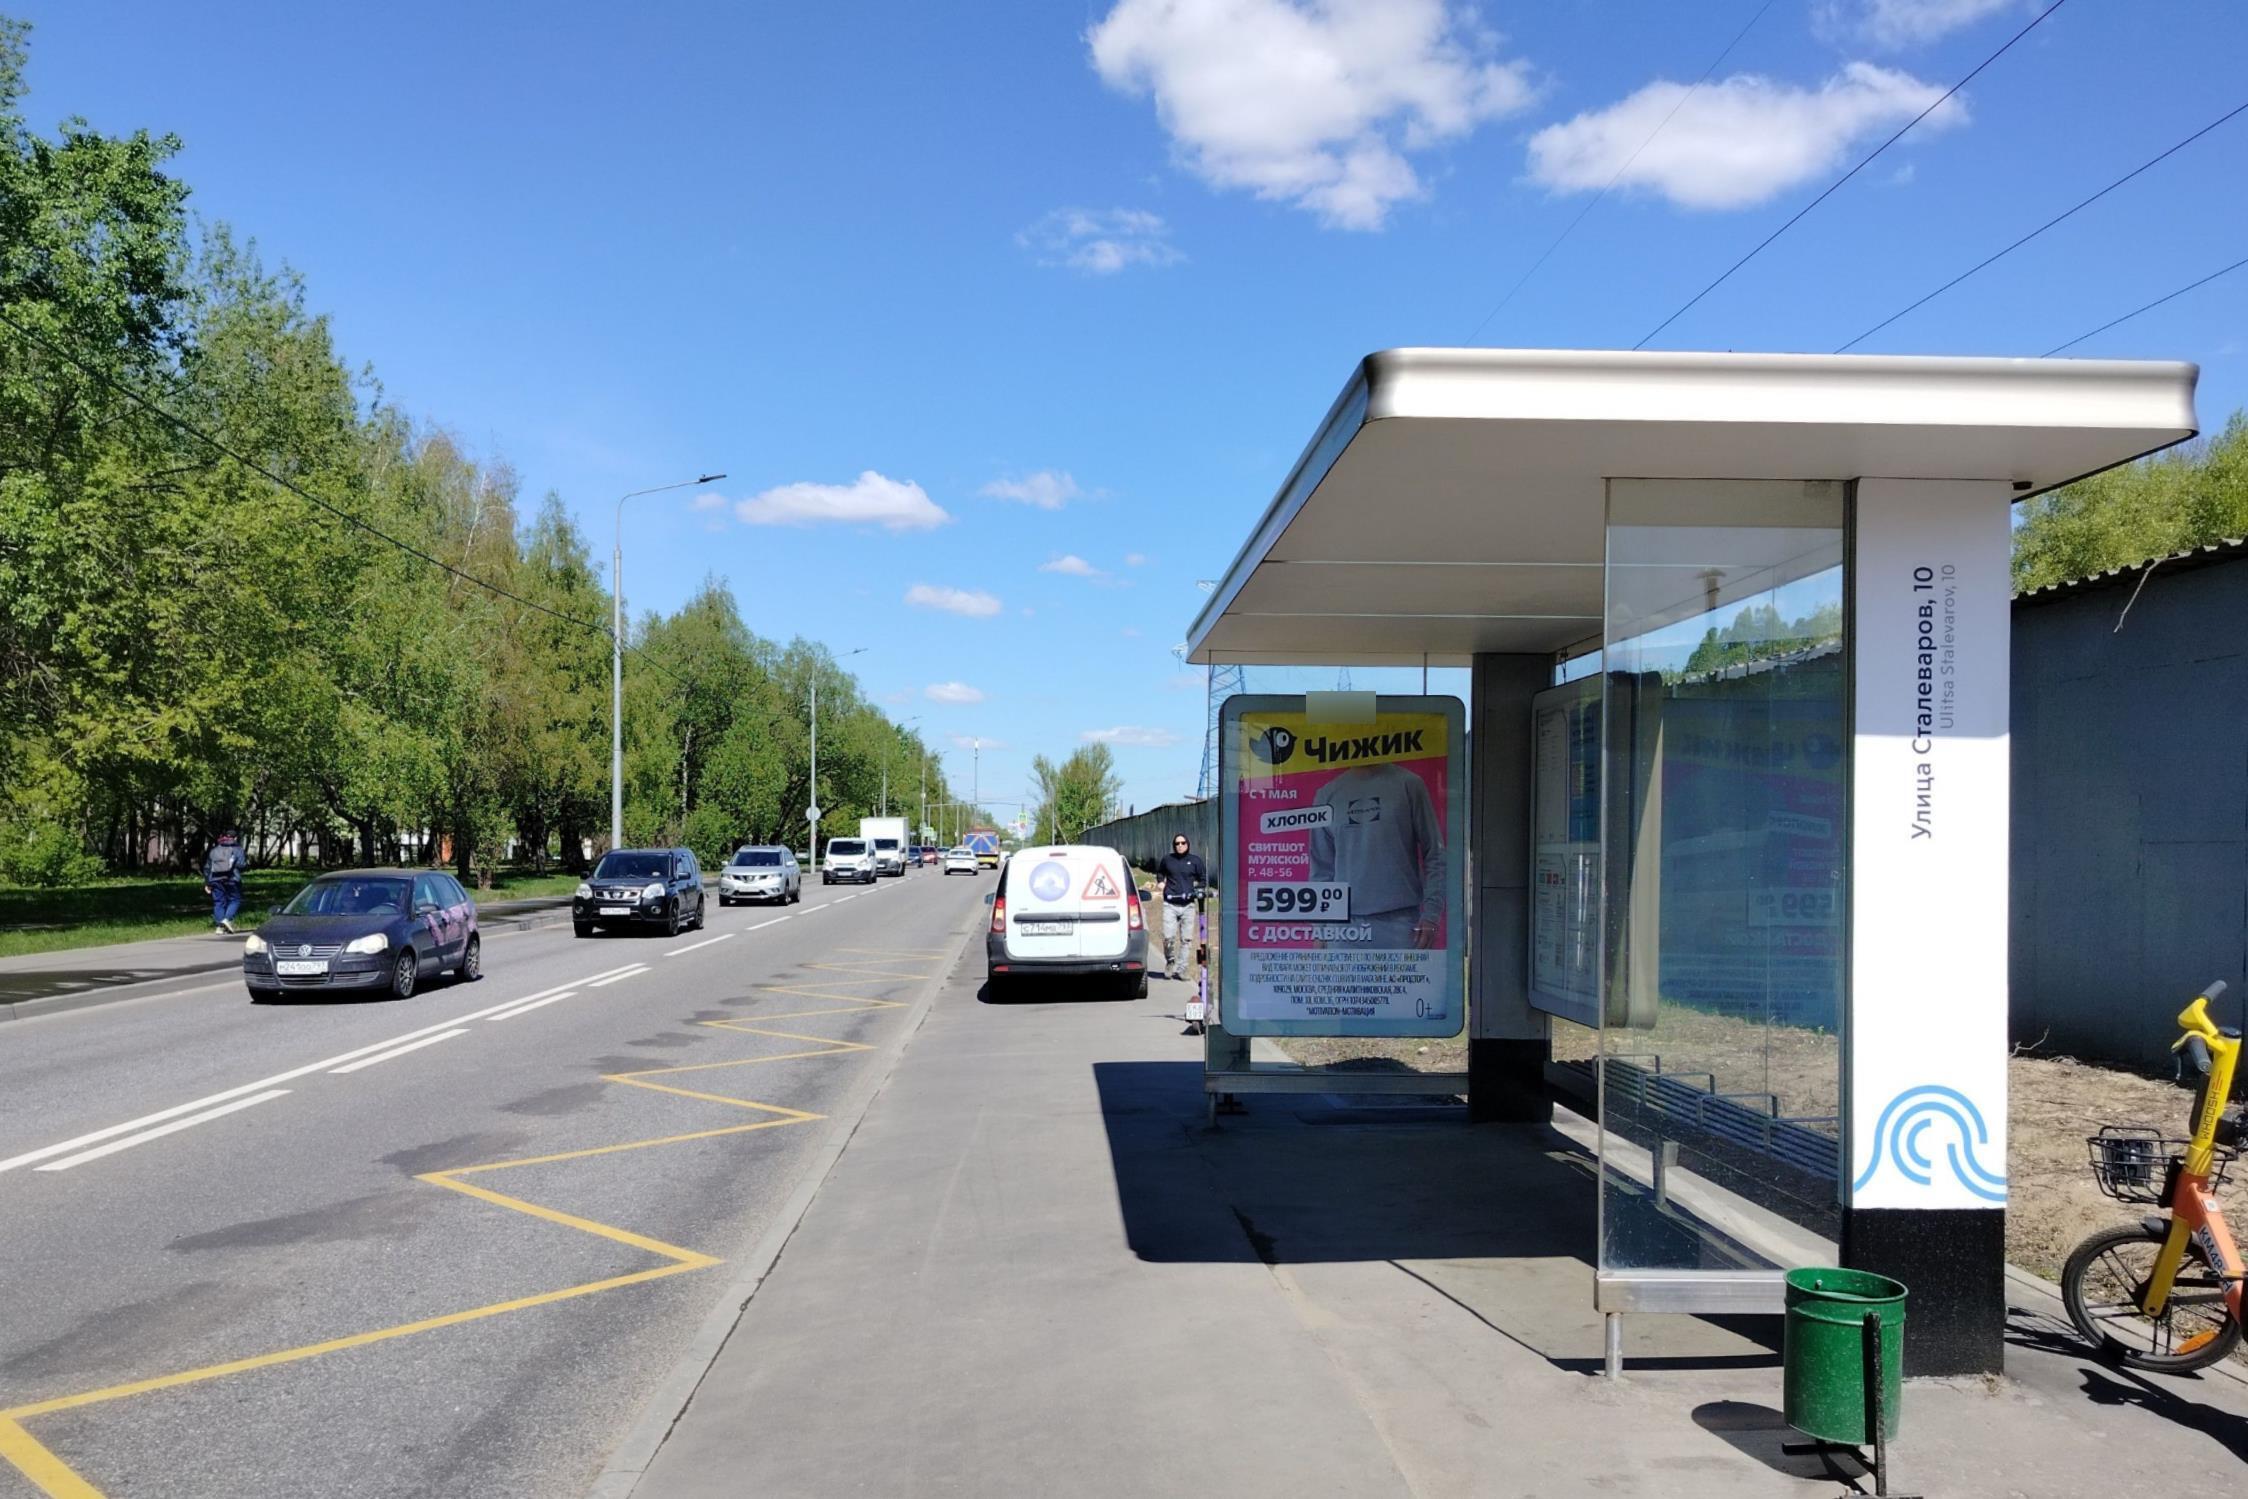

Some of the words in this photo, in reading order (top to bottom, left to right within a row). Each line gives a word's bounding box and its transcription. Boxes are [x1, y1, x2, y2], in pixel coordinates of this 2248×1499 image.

[1913, 565, 1935, 593] 10
[1940, 563, 1956, 582] 10
[1940, 585, 1957, 675] Stalevarov,
[1911, 599, 1938, 755] Сталеваров,
[1939, 679, 1956, 729] Ulitsa
[1249, 789, 1257, 799] С
[1268, 789, 1298, 799] МАЯ
[1911, 762, 1935, 840] Улица
[1266, 811, 1328, 829] ХЛОПОК
[1248, 842, 1305, 852] СВИТШОТ
[1248, 853, 1309, 865] МУЖСКОЙ
[1259, 868, 1293, 877] 48-56
[1256, 887, 1318, 913] 599
[1248, 926, 1259, 941] С
[1262, 922, 1373, 943] ДОСТАВКОЙ
[1415, 997, 1433, 1018] 0+
[2200, 1090, 2221, 1140] WHOOSH
